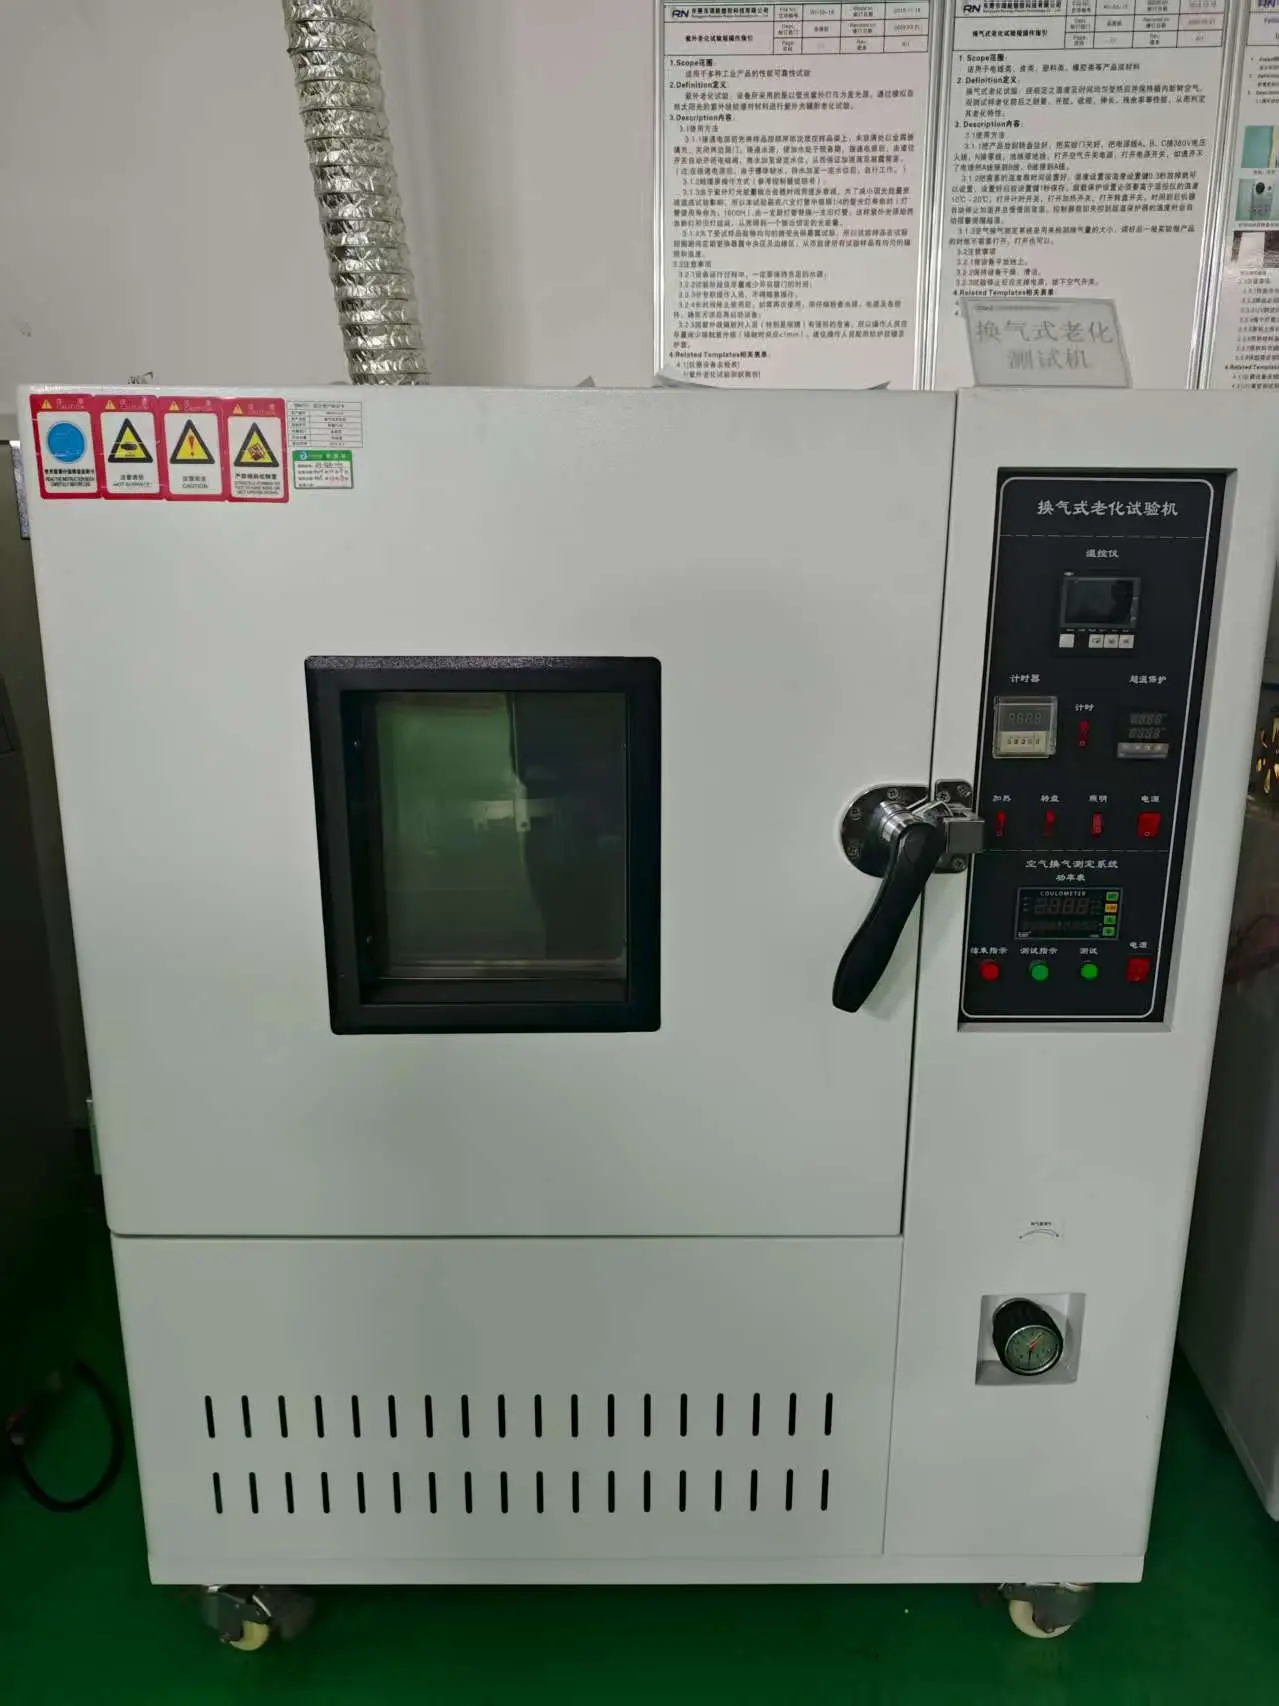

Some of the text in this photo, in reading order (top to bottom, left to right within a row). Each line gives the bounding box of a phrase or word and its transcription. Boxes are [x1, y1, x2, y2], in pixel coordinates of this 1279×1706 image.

[975, 319, 1115, 345] 换气式老化
[1006, 349, 1090, 370] 测试机
[1037, 500, 1178, 517] 换气式老化试验机
[1085, 549, 1119, 559] 温控仪
[1008, 673, 1041, 683] 计时器
[1128, 674, 1167, 685] 超温保护
[1075, 703, 1095, 712] 计时
[992, 794, 1012, 803] 加热
[1040, 794, 1060, 803] 转盘
[1089, 794, 1108, 803] 照明
[1141, 794, 1160, 803] 电源
[1025, 859, 1120, 870] 空气换气测定系统
[1056, 873, 1086, 882] 功率表
[1129, 940, 1148, 949] 电源
[1020, 947, 1058, 955] 测试指示
[1080, 947, 1098, 955] 测试
